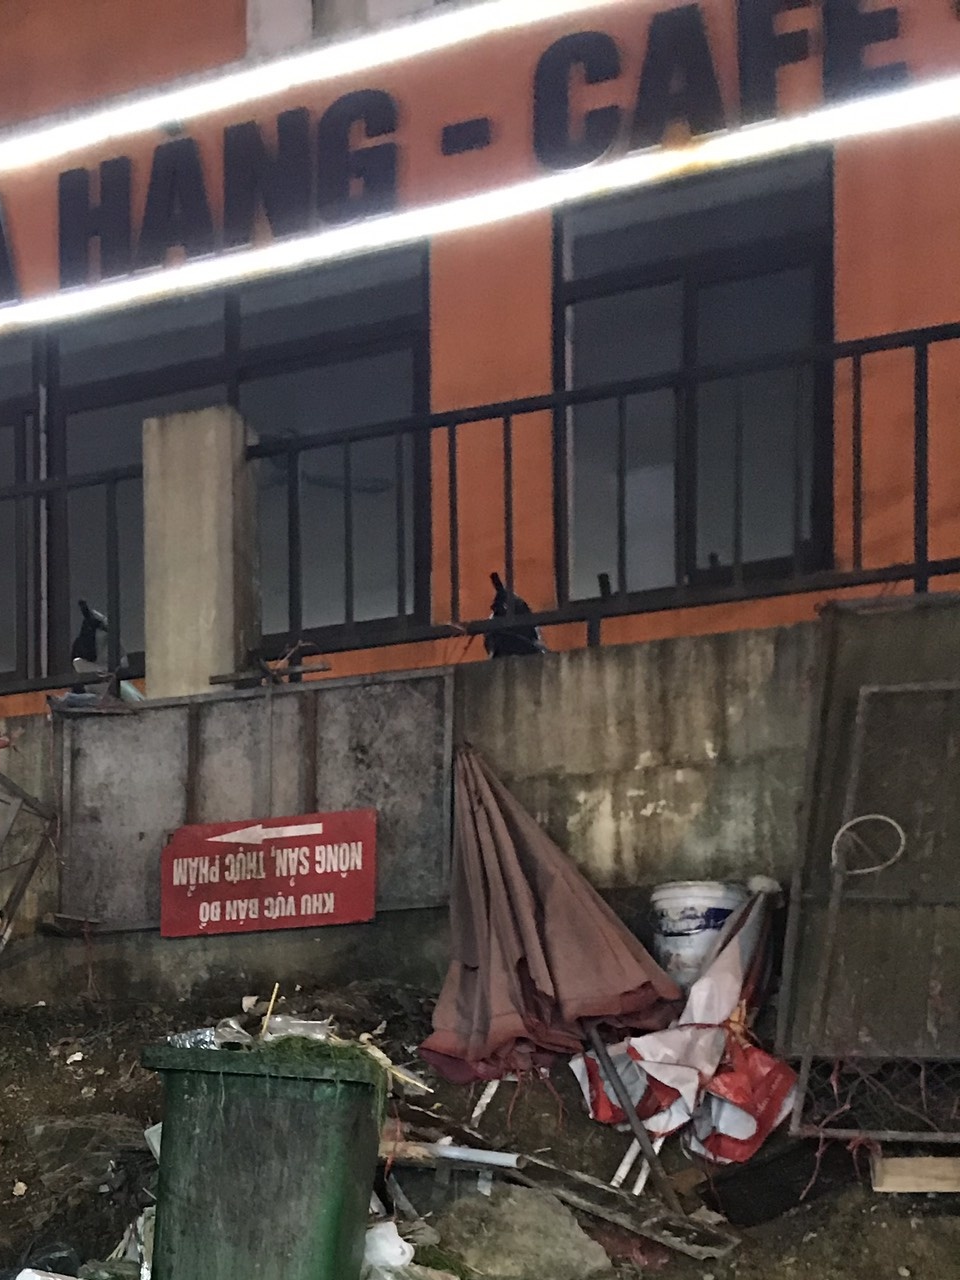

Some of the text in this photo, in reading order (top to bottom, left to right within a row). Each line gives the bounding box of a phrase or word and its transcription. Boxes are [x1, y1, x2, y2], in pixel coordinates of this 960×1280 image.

[58, 89, 398, 289] HÀNG
[532, 0, 909, 172] CAFE
[173, 841, 363, 896] NÔNG SẢN, THỰC PHẨM
[225, 899, 259, 925] BÁN
[264, 892, 296, 920] VỰC
[301, 893, 335, 915] KHU
